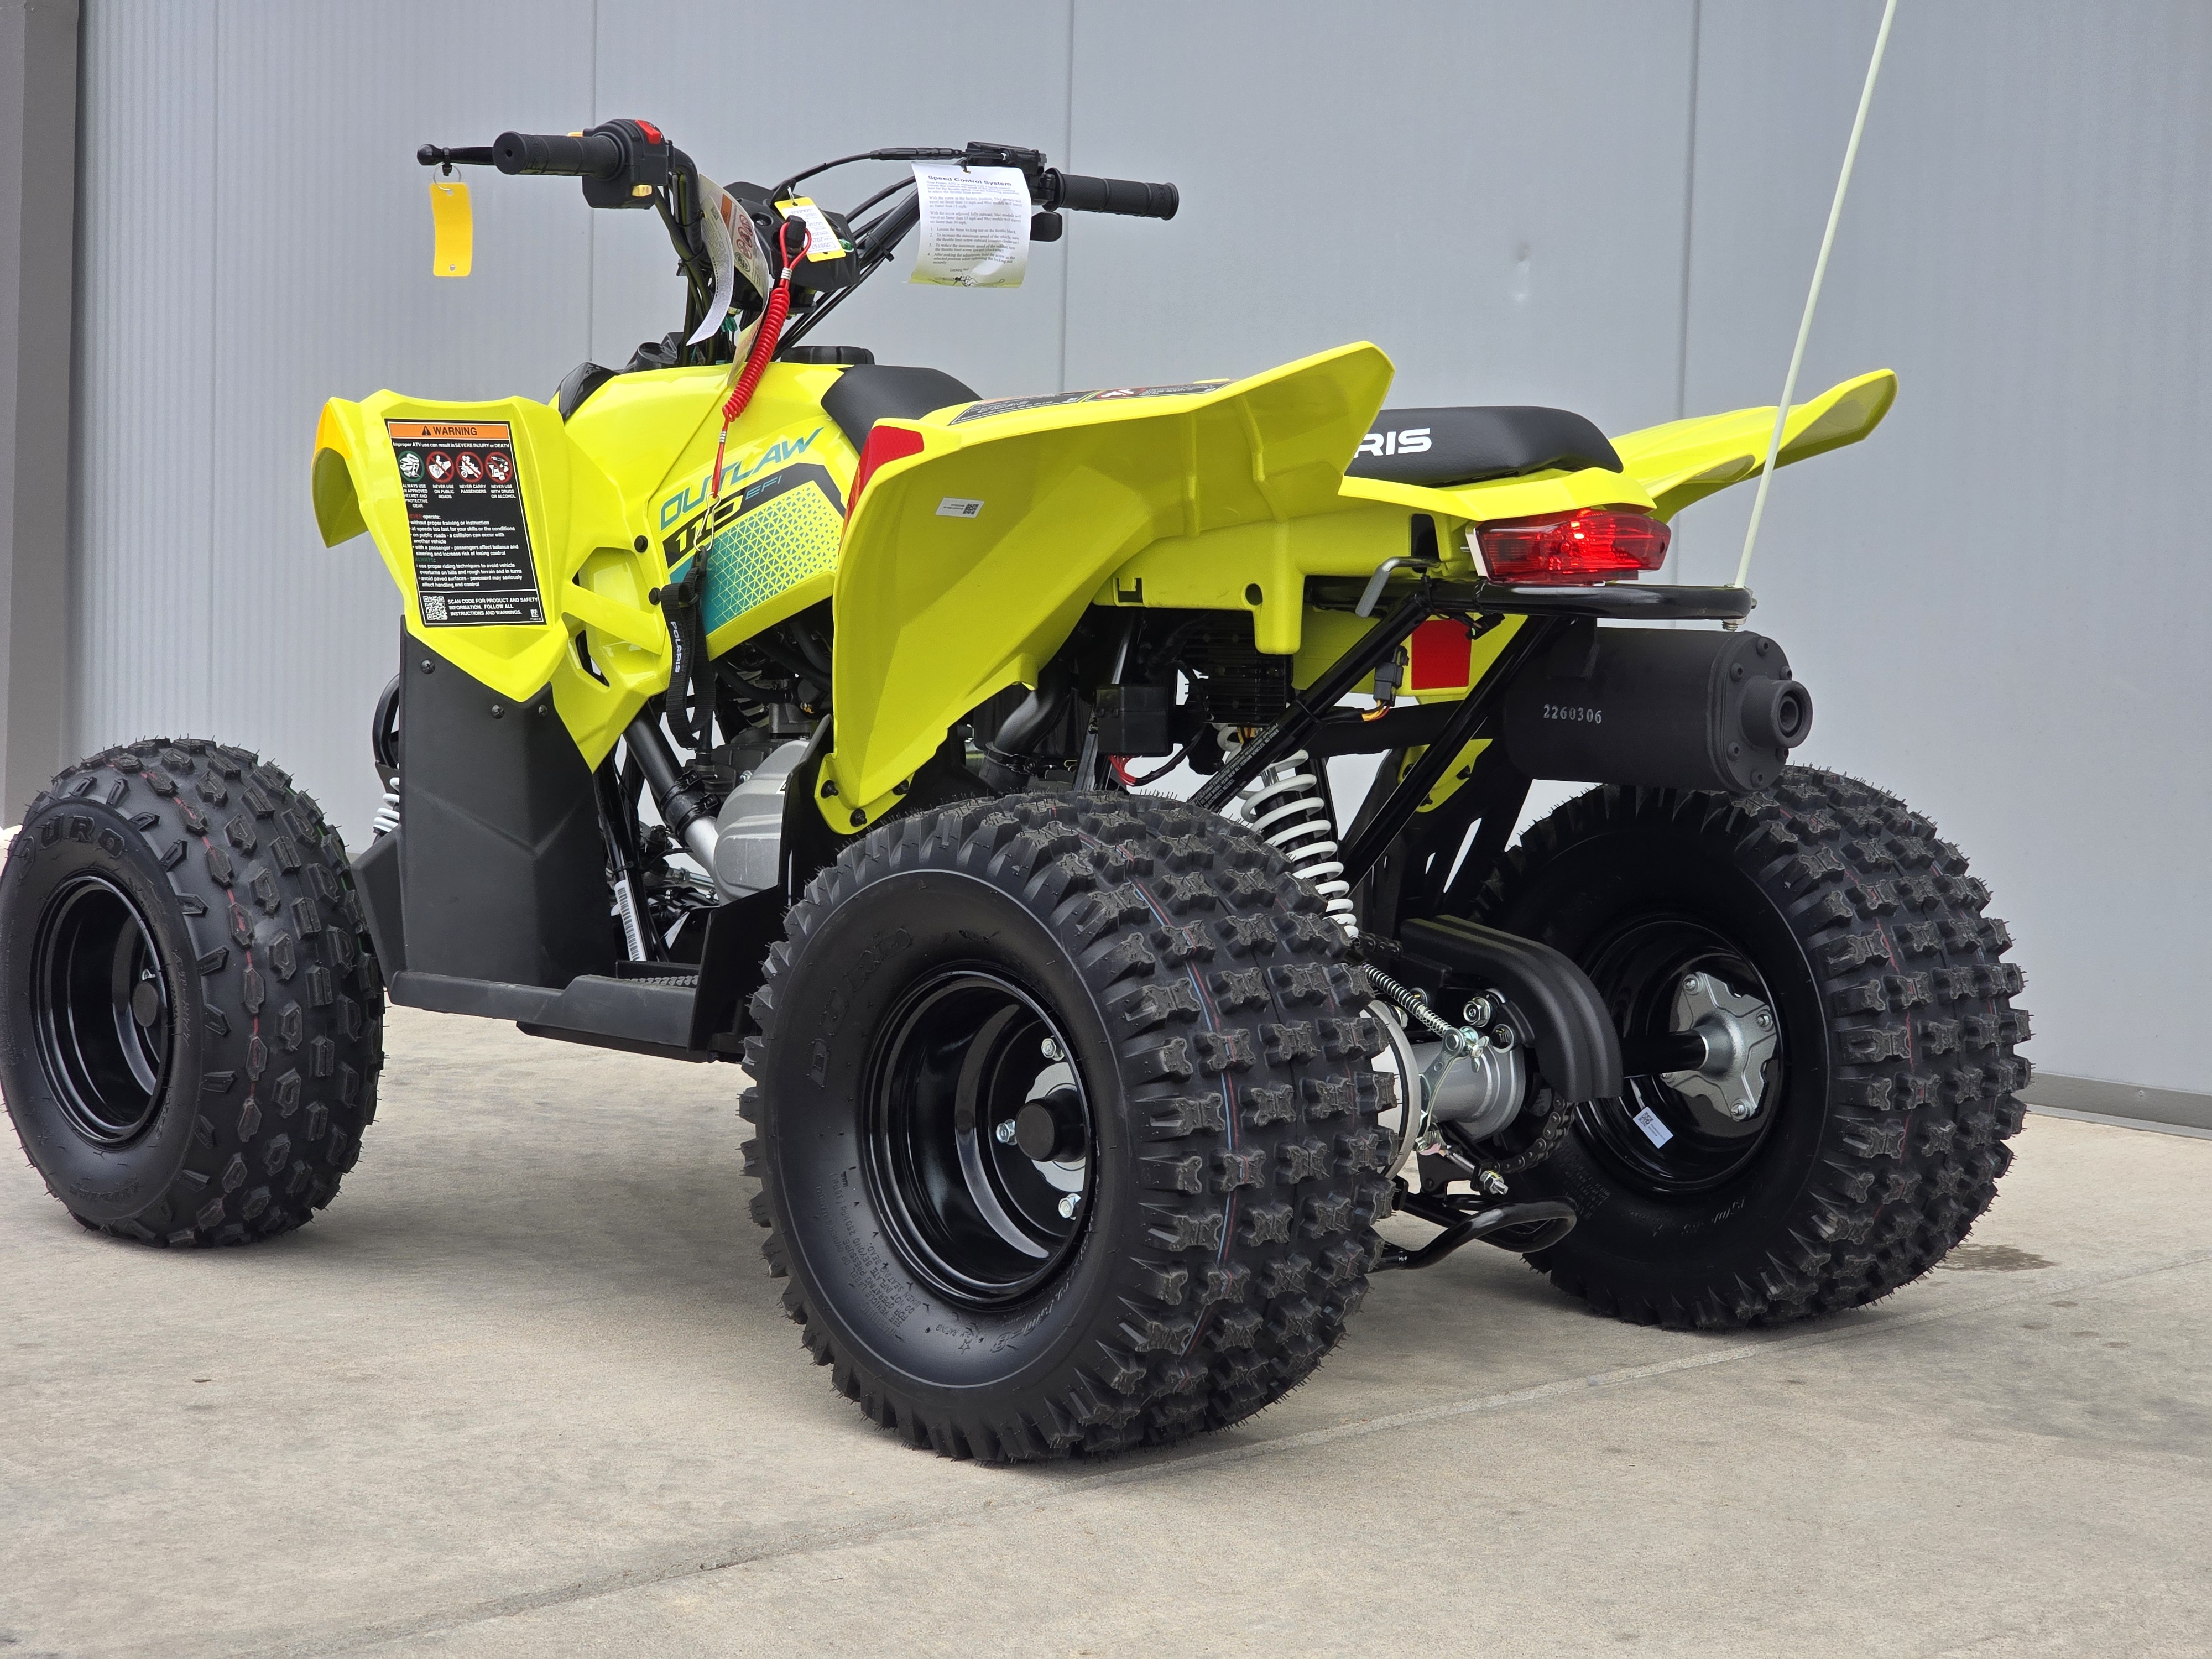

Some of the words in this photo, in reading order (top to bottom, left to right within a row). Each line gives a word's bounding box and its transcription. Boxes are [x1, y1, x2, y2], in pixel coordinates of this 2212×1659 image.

[433, 426, 477, 435] WARNING
[1353, 428, 1432, 458] RIS
[661, 427, 825, 532] OUTLAW
[745, 474, 782, 500] EFI
[675, 495, 744, 552] 110
[670, 621, 682, 673] POLARIS
[1543, 703, 1602, 724] 2260306
[807, 927, 913, 1089] DURO
[841, 1256, 851, 1266] OR
[843, 1238, 865, 1276] PRESSURE
[853, 1238, 873, 1267] BEYOND
[849, 1270, 867, 1291] LABEL
[870, 1267, 892, 1295] INFLATE
[880, 1266, 904, 1292] SEATING
[864, 1276, 894, 1310] OPERATING
[865, 1292, 889, 1318] VEHICLE
[890, 1296, 905, 1310] NOT
[904, 1292, 921, 1307] WHEN
[889, 1318, 902, 1328] SEE
[893, 1310, 909, 1322] FOR
[904, 1306, 916, 1315] DO
